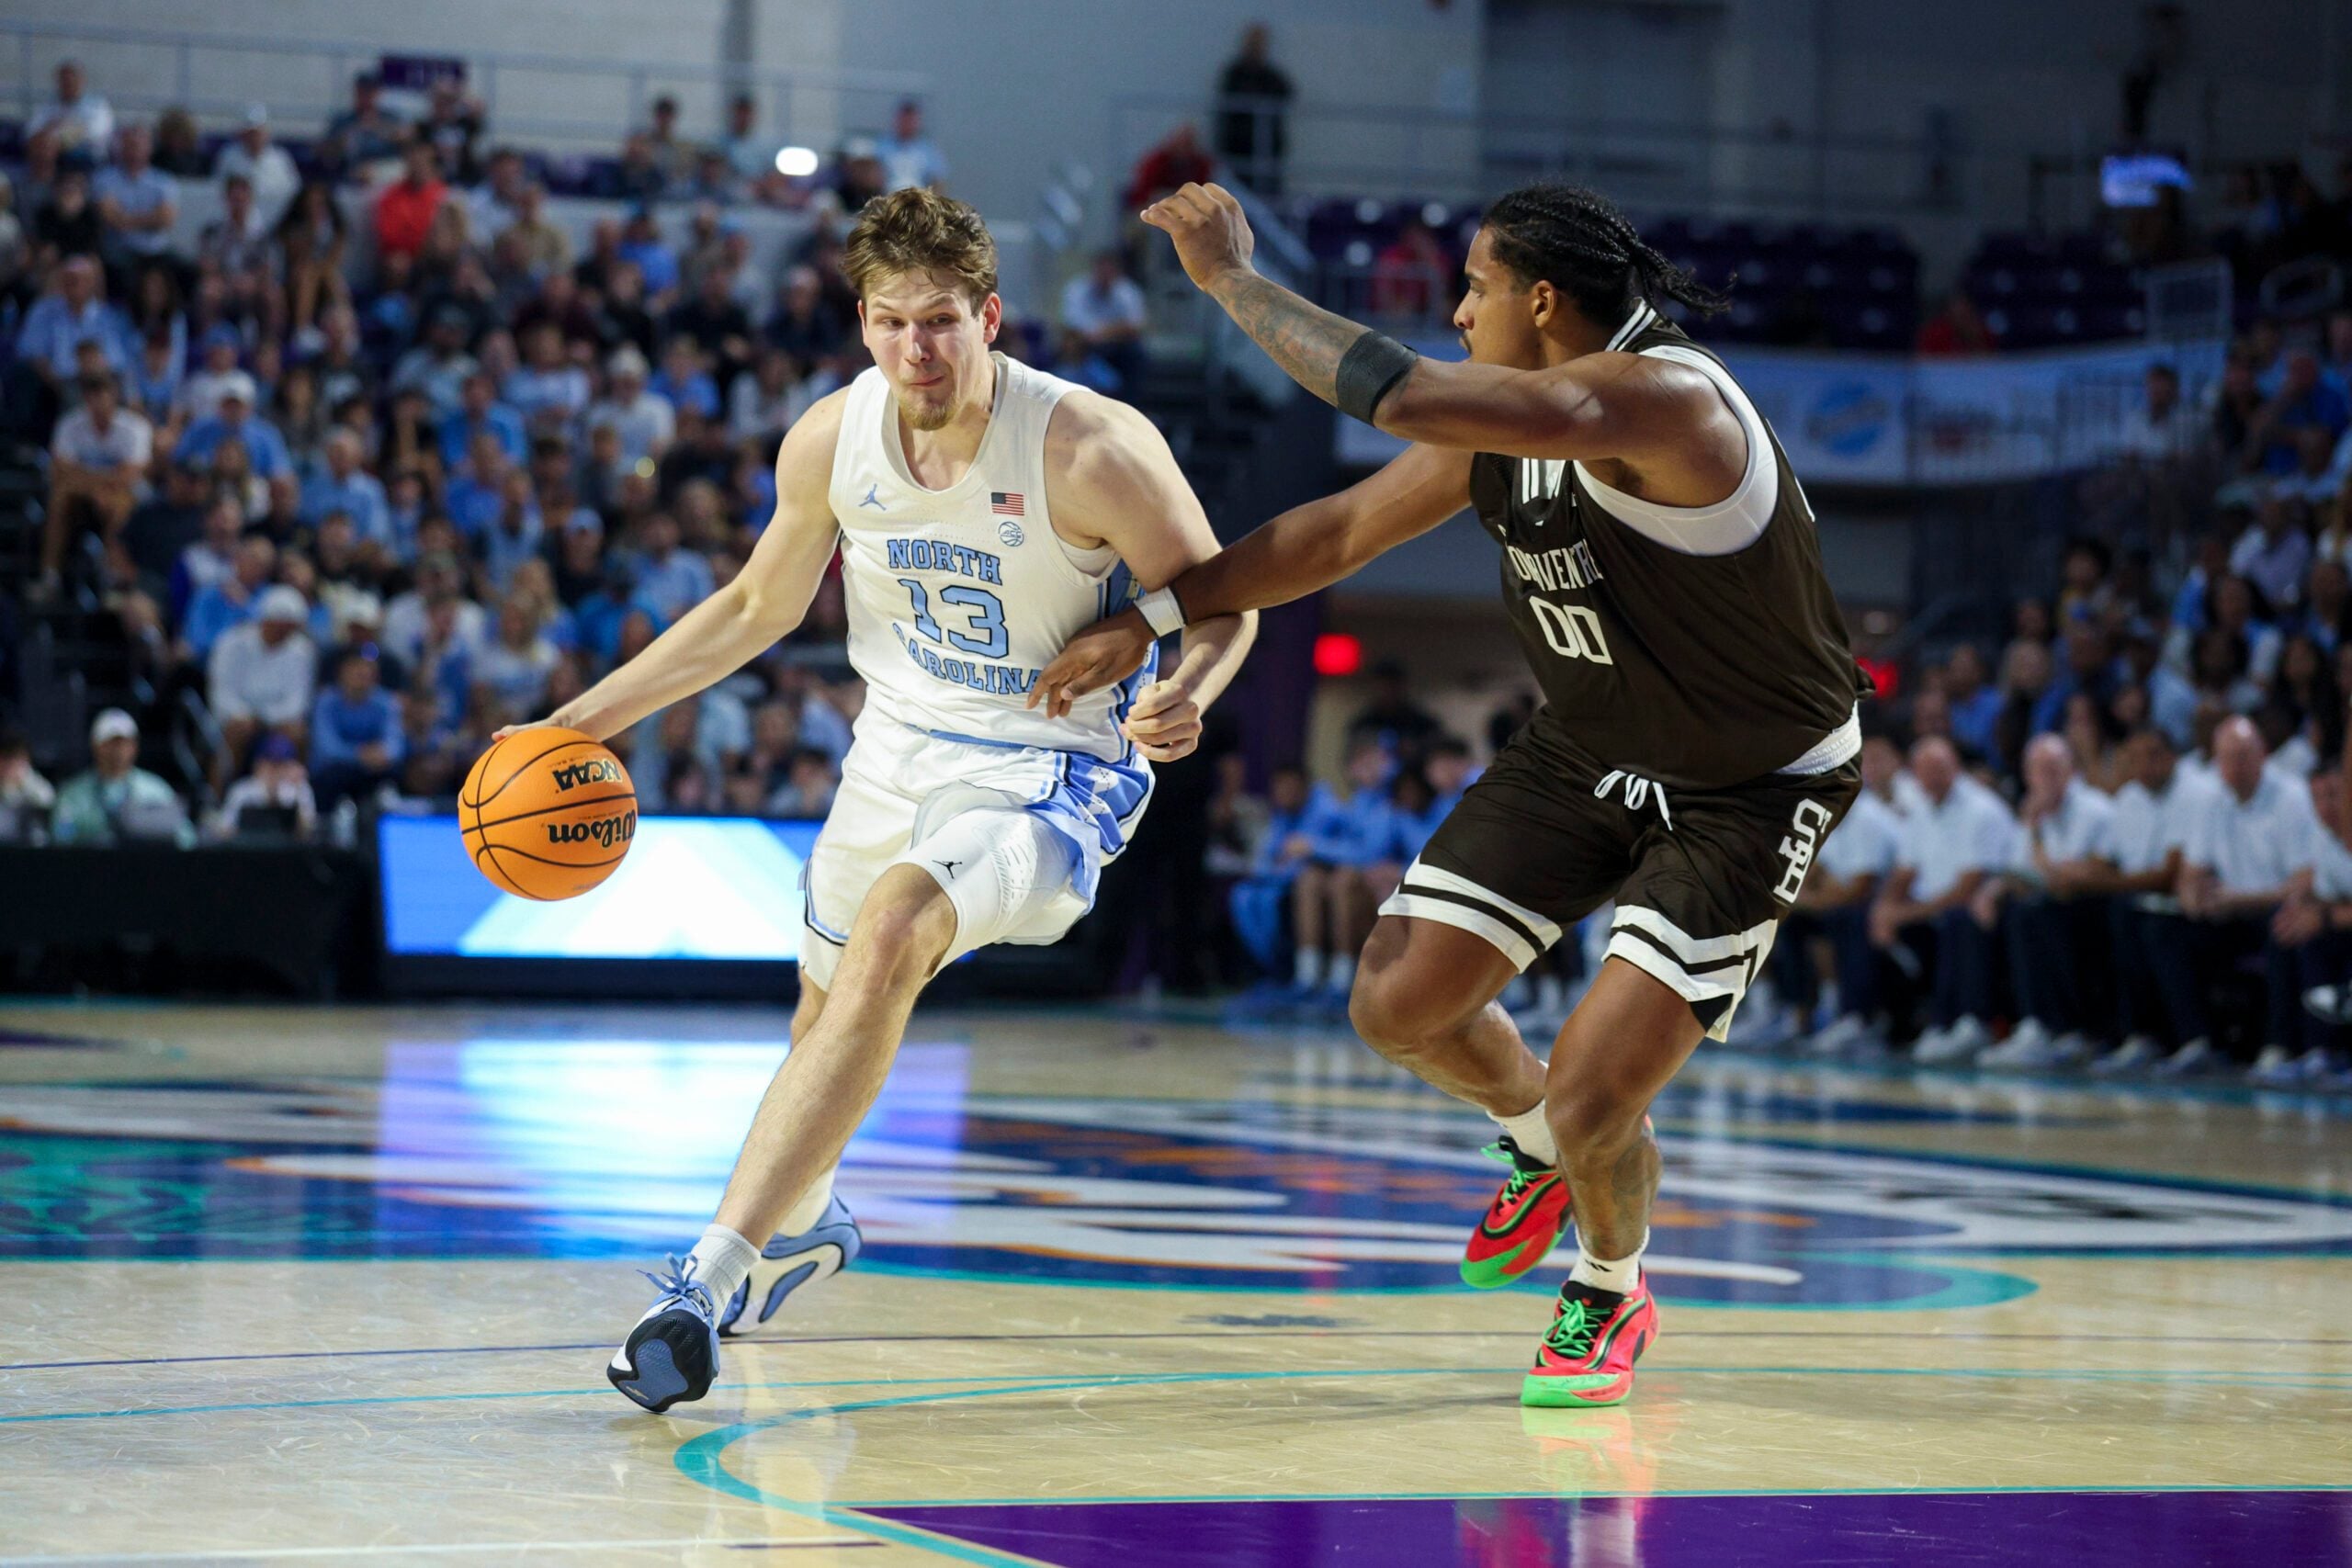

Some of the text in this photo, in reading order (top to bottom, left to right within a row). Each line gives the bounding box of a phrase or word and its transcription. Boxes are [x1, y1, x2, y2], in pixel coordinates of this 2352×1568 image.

[887, 538, 1002, 586] NORTH
[897, 578, 1010, 660] 13
[1529, 595, 1613, 665] 00
[552, 758, 623, 791] NCAA
[548, 809, 636, 849] Wilson
